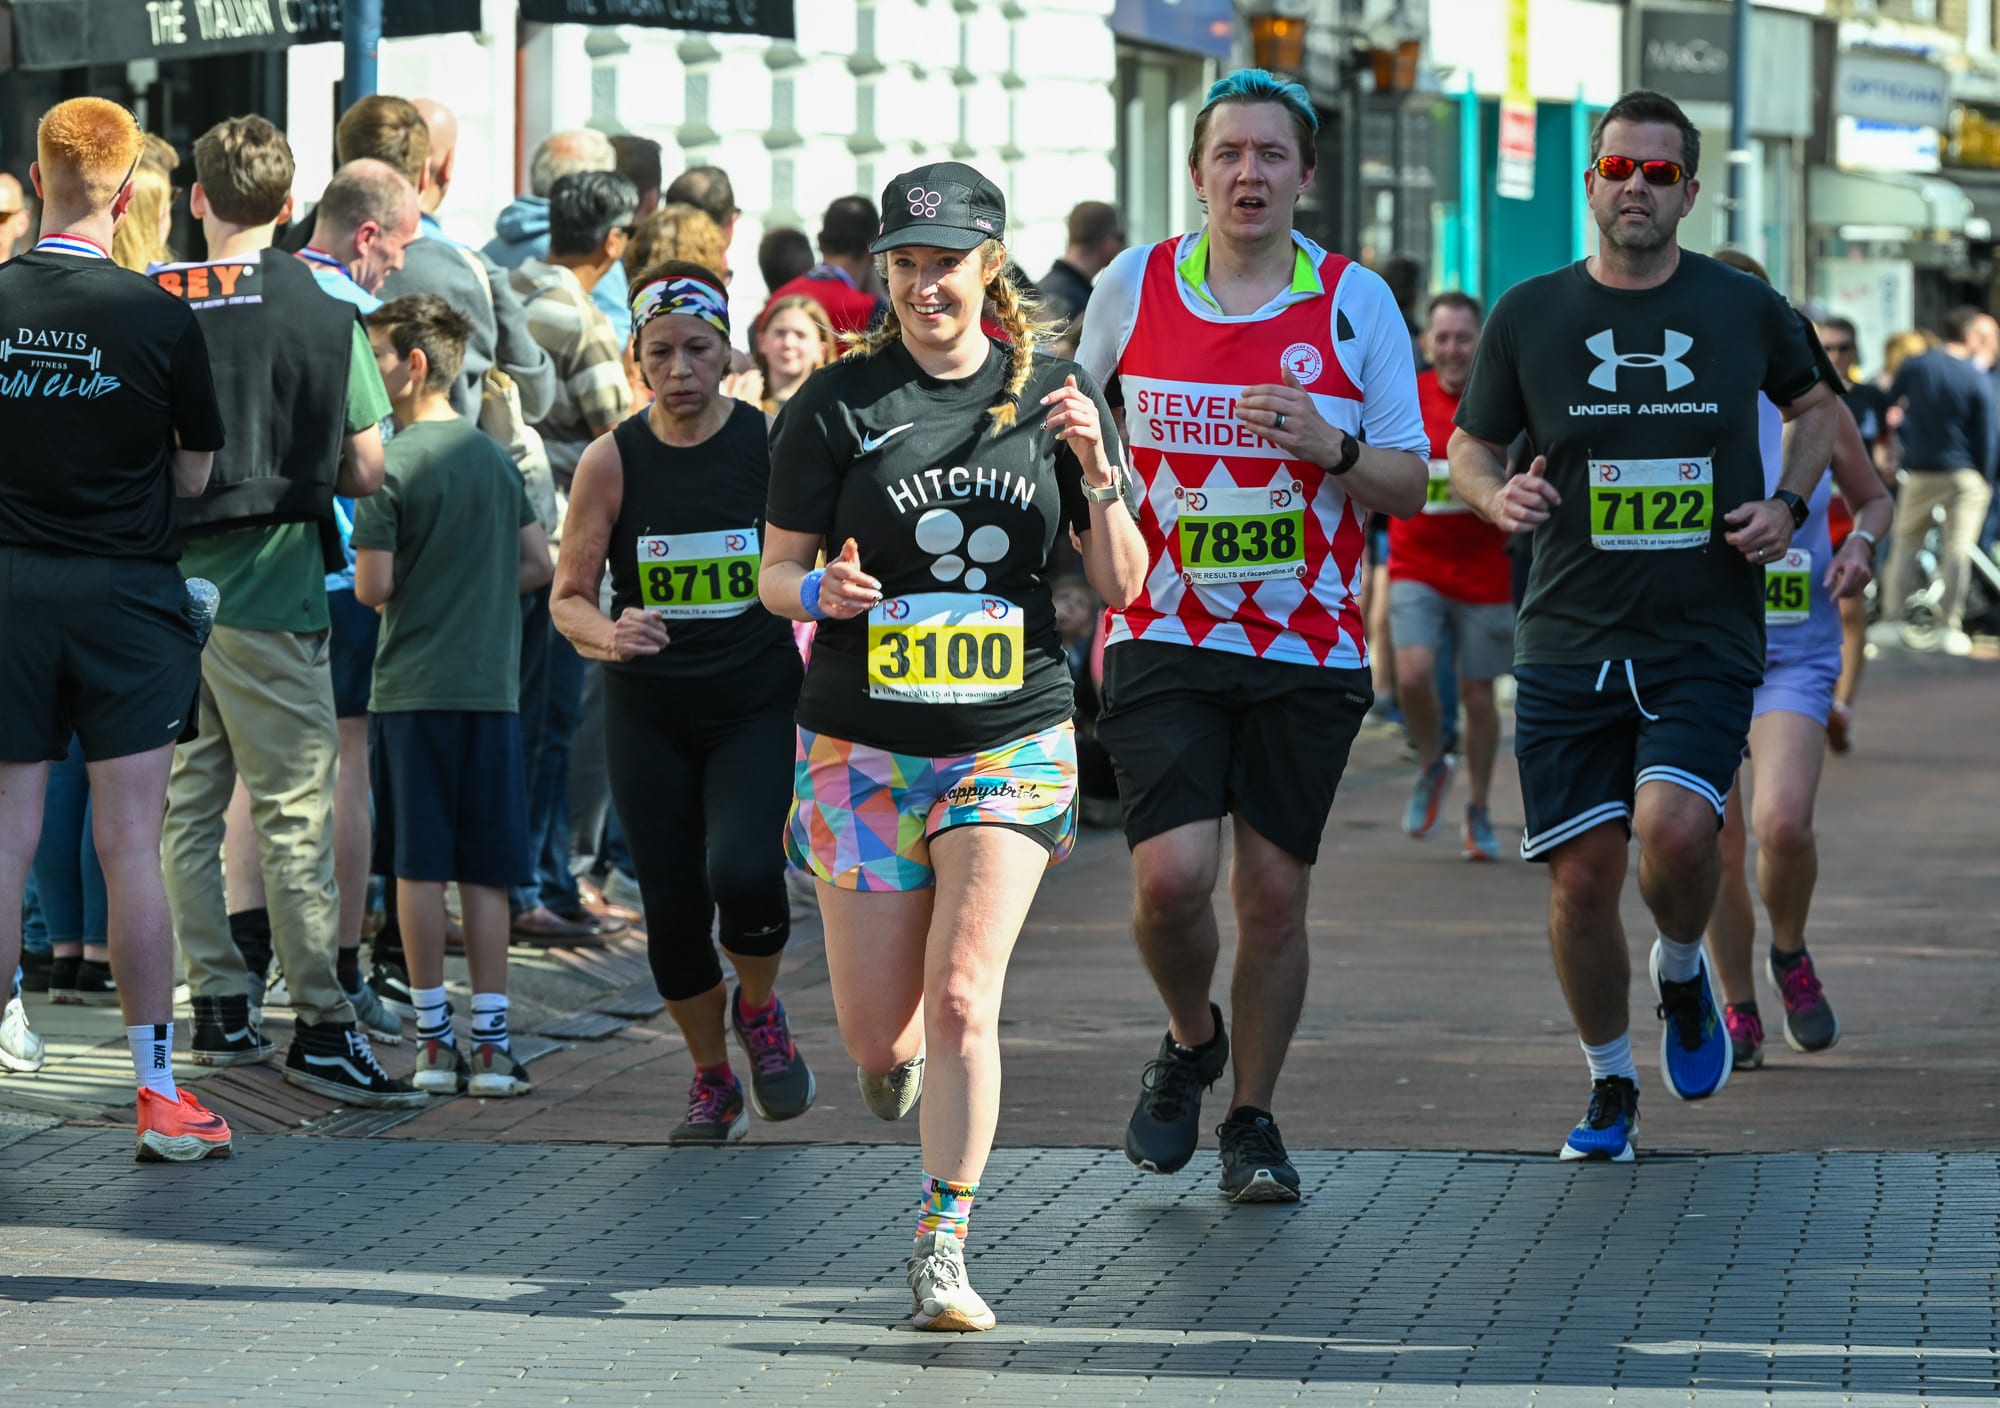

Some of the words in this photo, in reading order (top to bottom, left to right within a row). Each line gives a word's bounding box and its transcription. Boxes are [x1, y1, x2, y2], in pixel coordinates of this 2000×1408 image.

[16, 327, 87, 350] DAVIS
[31, 359, 68, 370] FITNESS
[42, 371, 122, 399] CLUB
[1568, 404, 1631, 416] UNDER
[1637, 402, 1719, 414] ARMOUR
[887, 467, 1036, 514] HITCHIN
[1598, 490, 1704, 531] 7122
[1184, 517, 1296, 563] 7838
[648, 561, 754, 602] 8718
[1204, 571, 1237, 579] RESULTS
[879, 632, 1012, 679] 3100
[154, 1044, 166, 1069] NIKE
